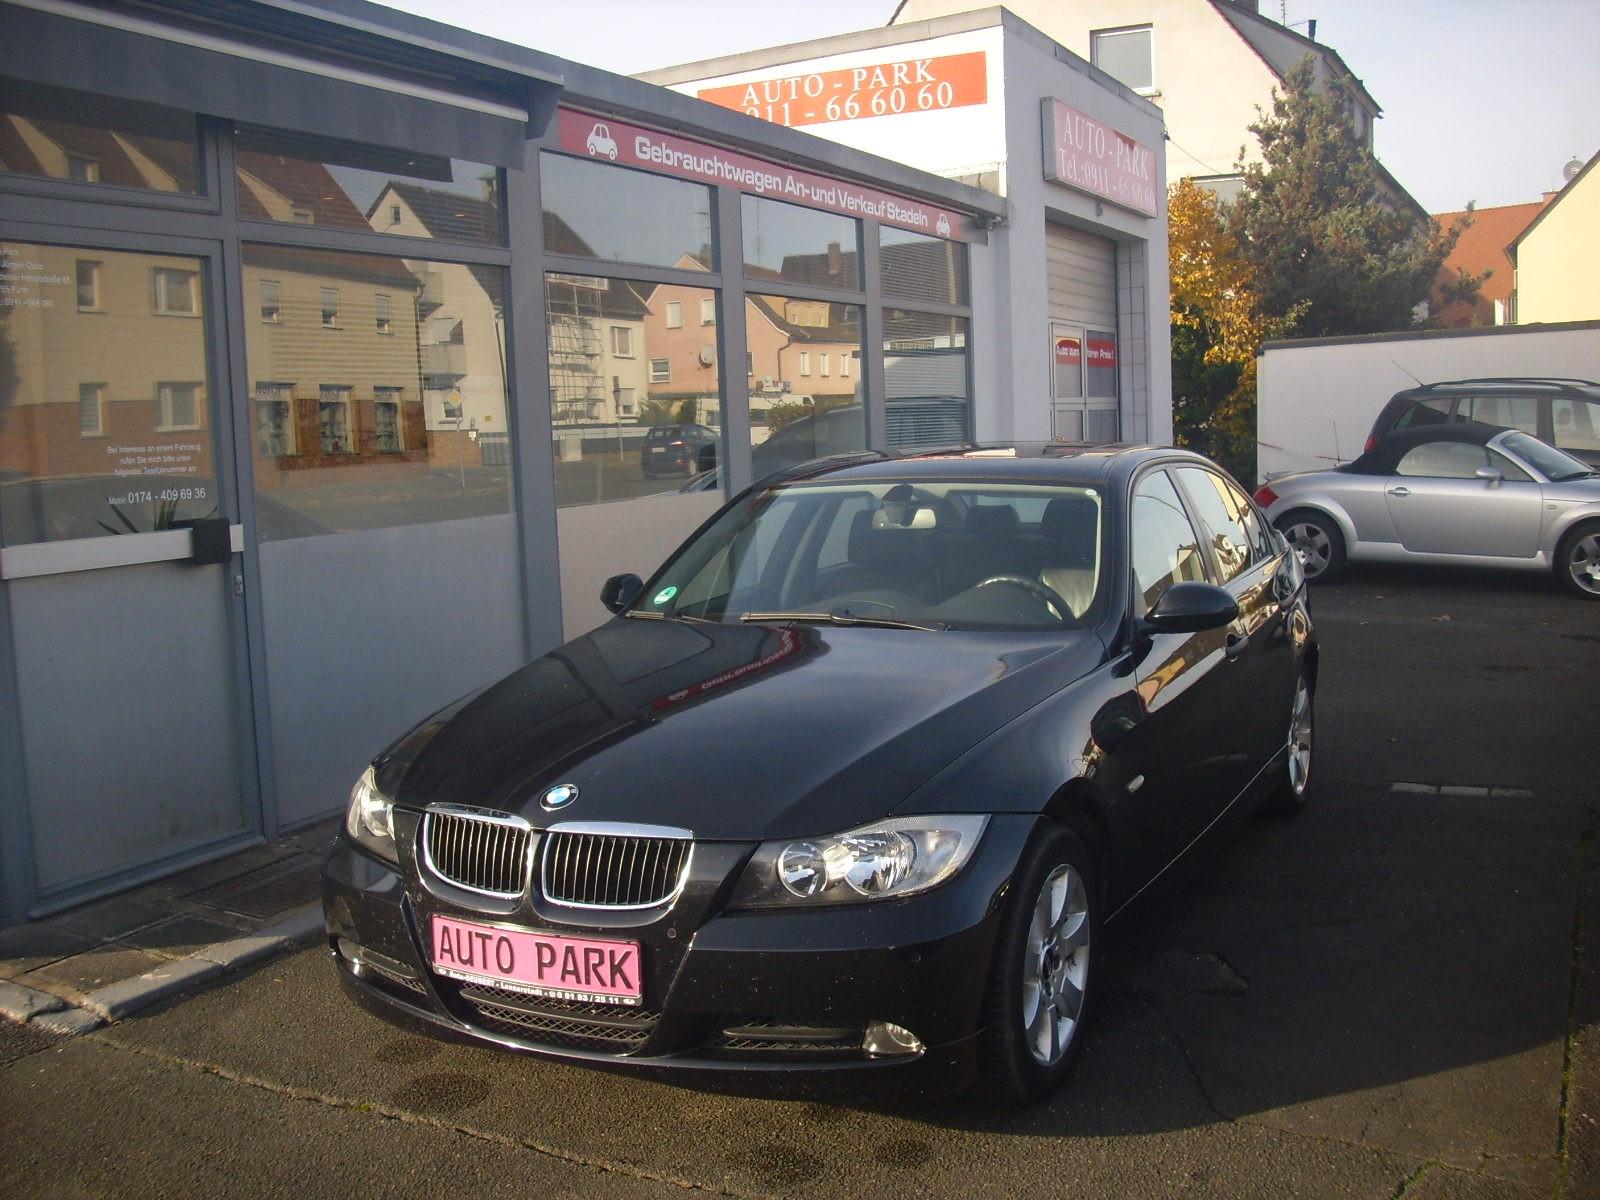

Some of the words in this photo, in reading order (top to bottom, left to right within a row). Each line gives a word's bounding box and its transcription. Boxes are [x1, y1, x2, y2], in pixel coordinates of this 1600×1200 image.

[741, 75, 824, 106] AUTO
[852, 59, 936, 91] PARK
[826, 95, 860, 121] 66
[872, 88, 906, 116] 60
[918, 81, 953, 109] 60
[1064, 111, 1105, 159] AUTO
[1116, 138, 1149, 180] PARK
[634, 135, 782, 192] Gebrauchtwagen
[837, 188, 886, 218] Verkauf
[887, 202, 929, 228] Stadeln
[128, 490, 152, 504] 0174
[161, 489, 179, 501] 409
[180, 488, 192, 500] 69
[194, 487, 206, 499] 36
[439, 925, 514, 974] AUTO
[534, 942, 634, 989] PARK
